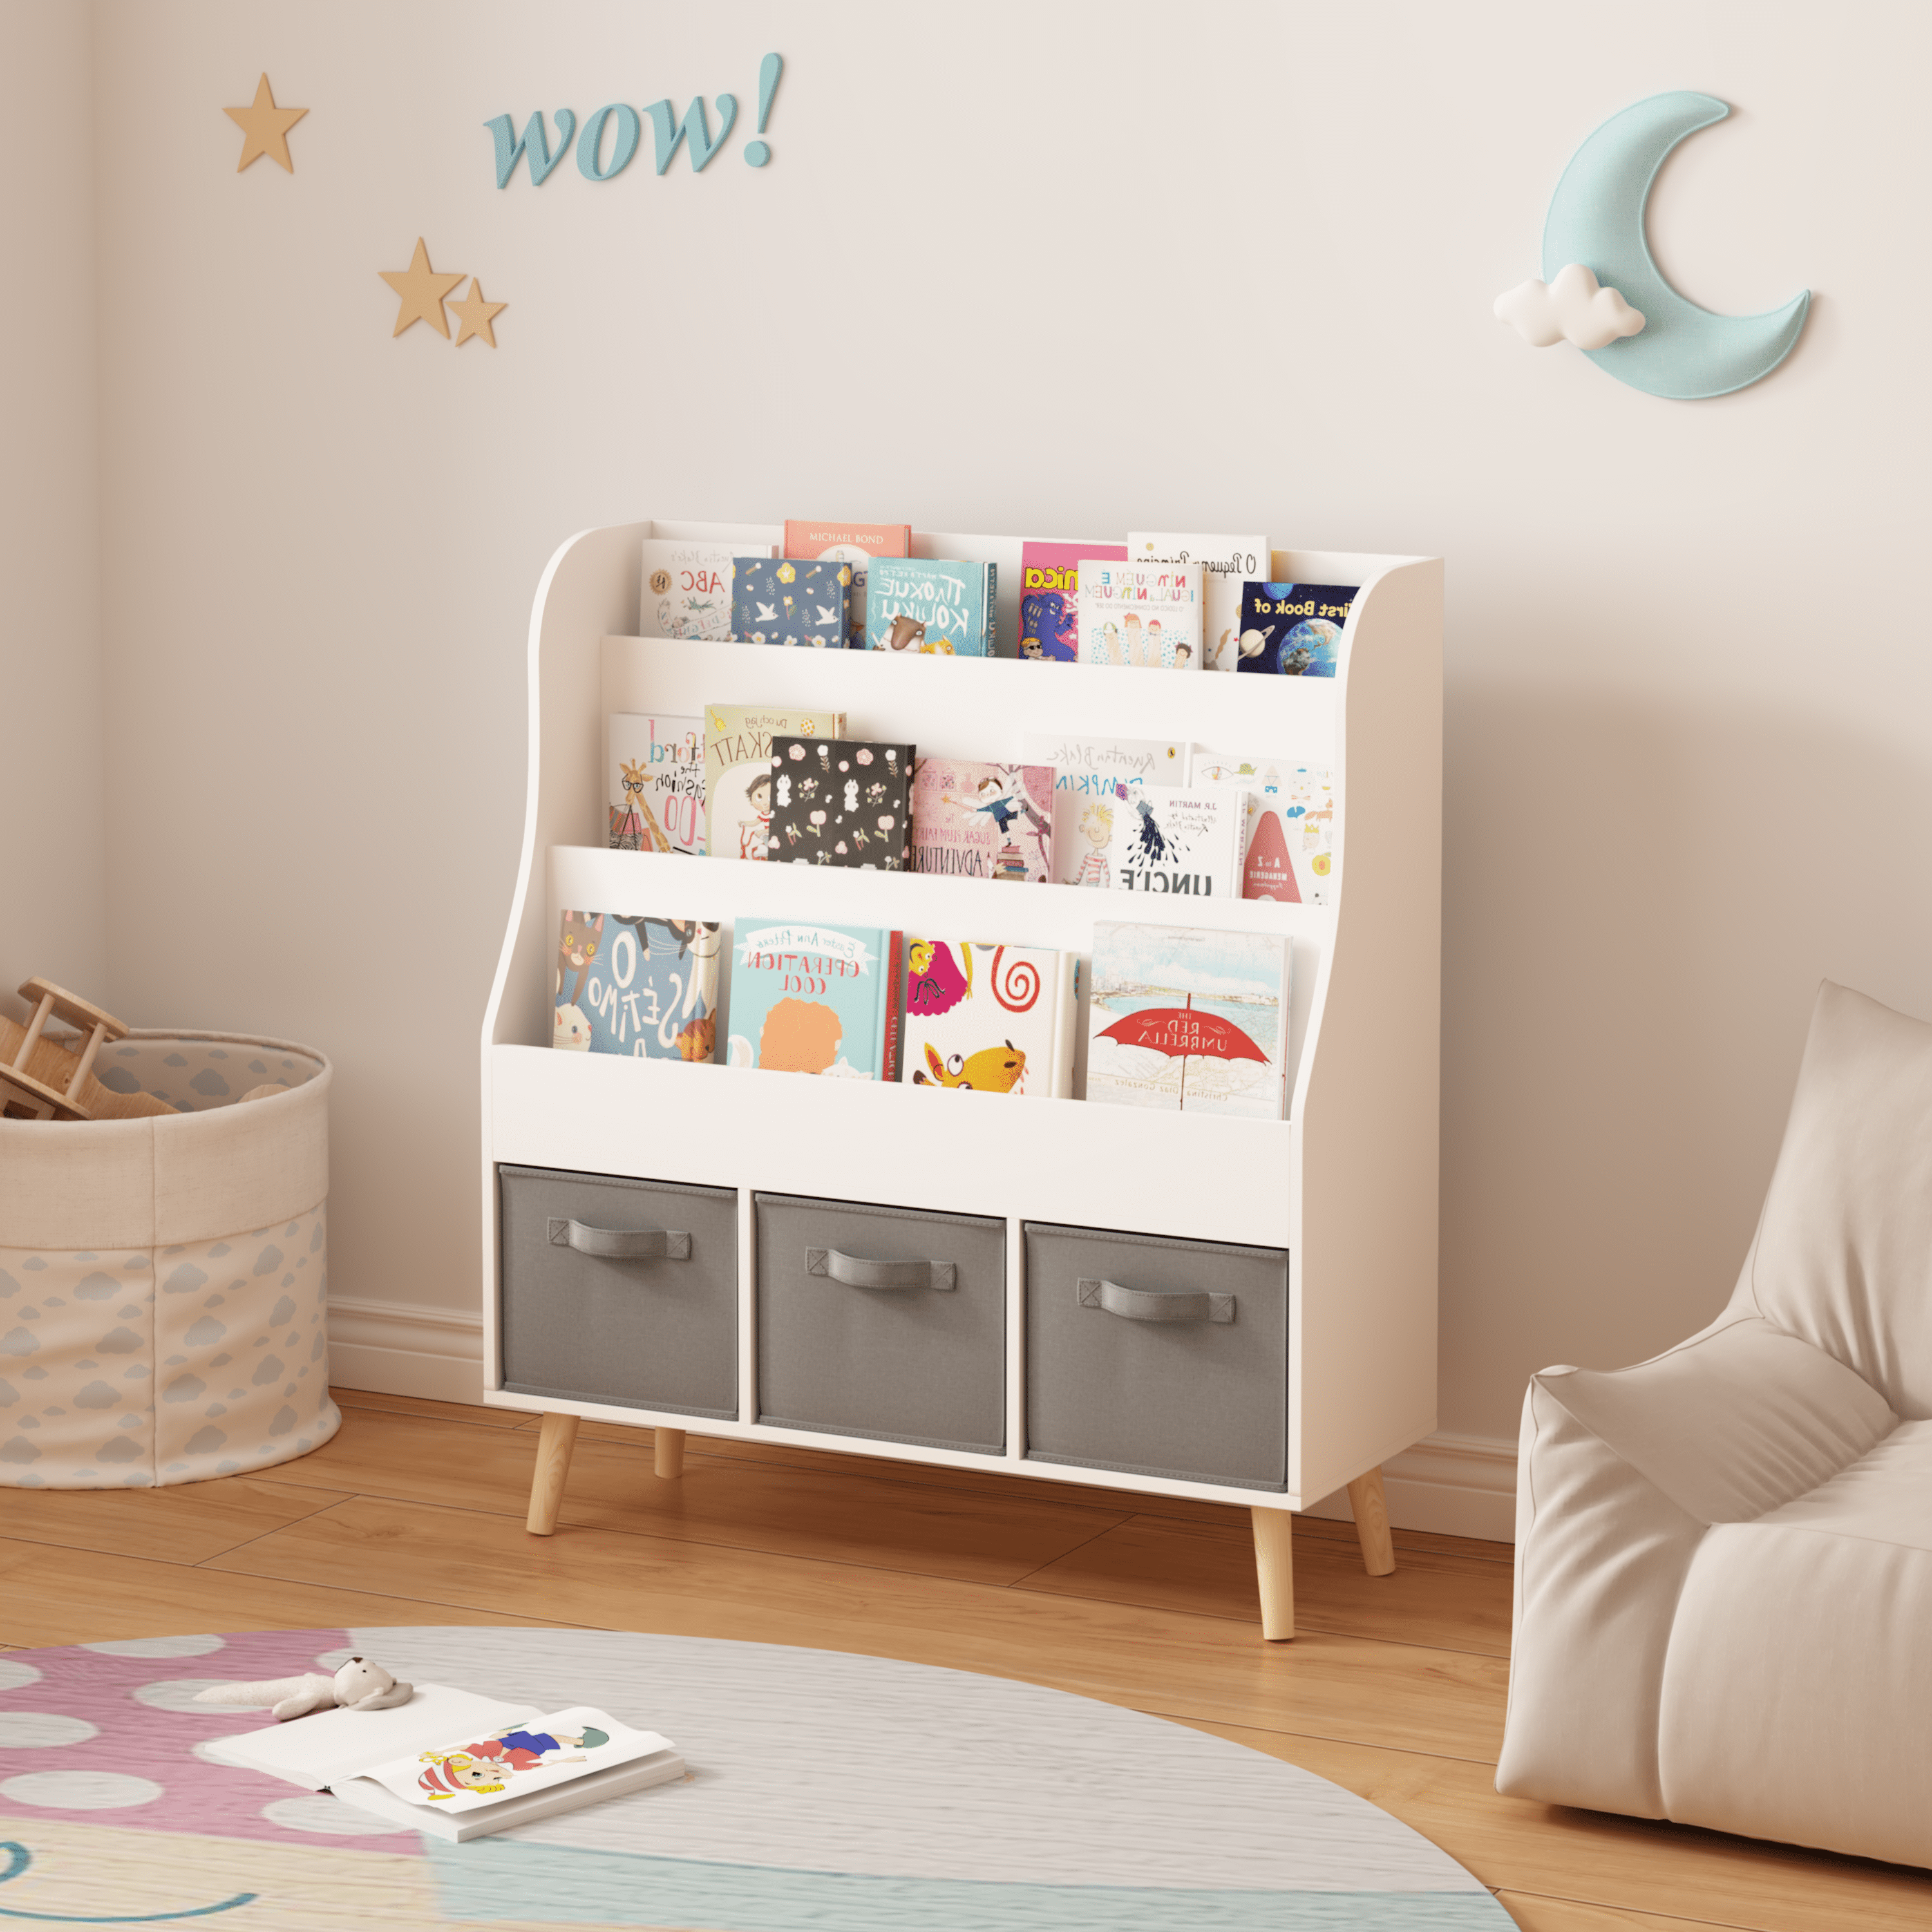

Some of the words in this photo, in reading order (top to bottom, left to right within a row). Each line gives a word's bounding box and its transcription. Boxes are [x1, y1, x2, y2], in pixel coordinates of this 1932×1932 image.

[483, 52, 783, 189] wow!
[810, 533, 853, 543] MICHAEL
[855, 534, 884, 544] BOND
